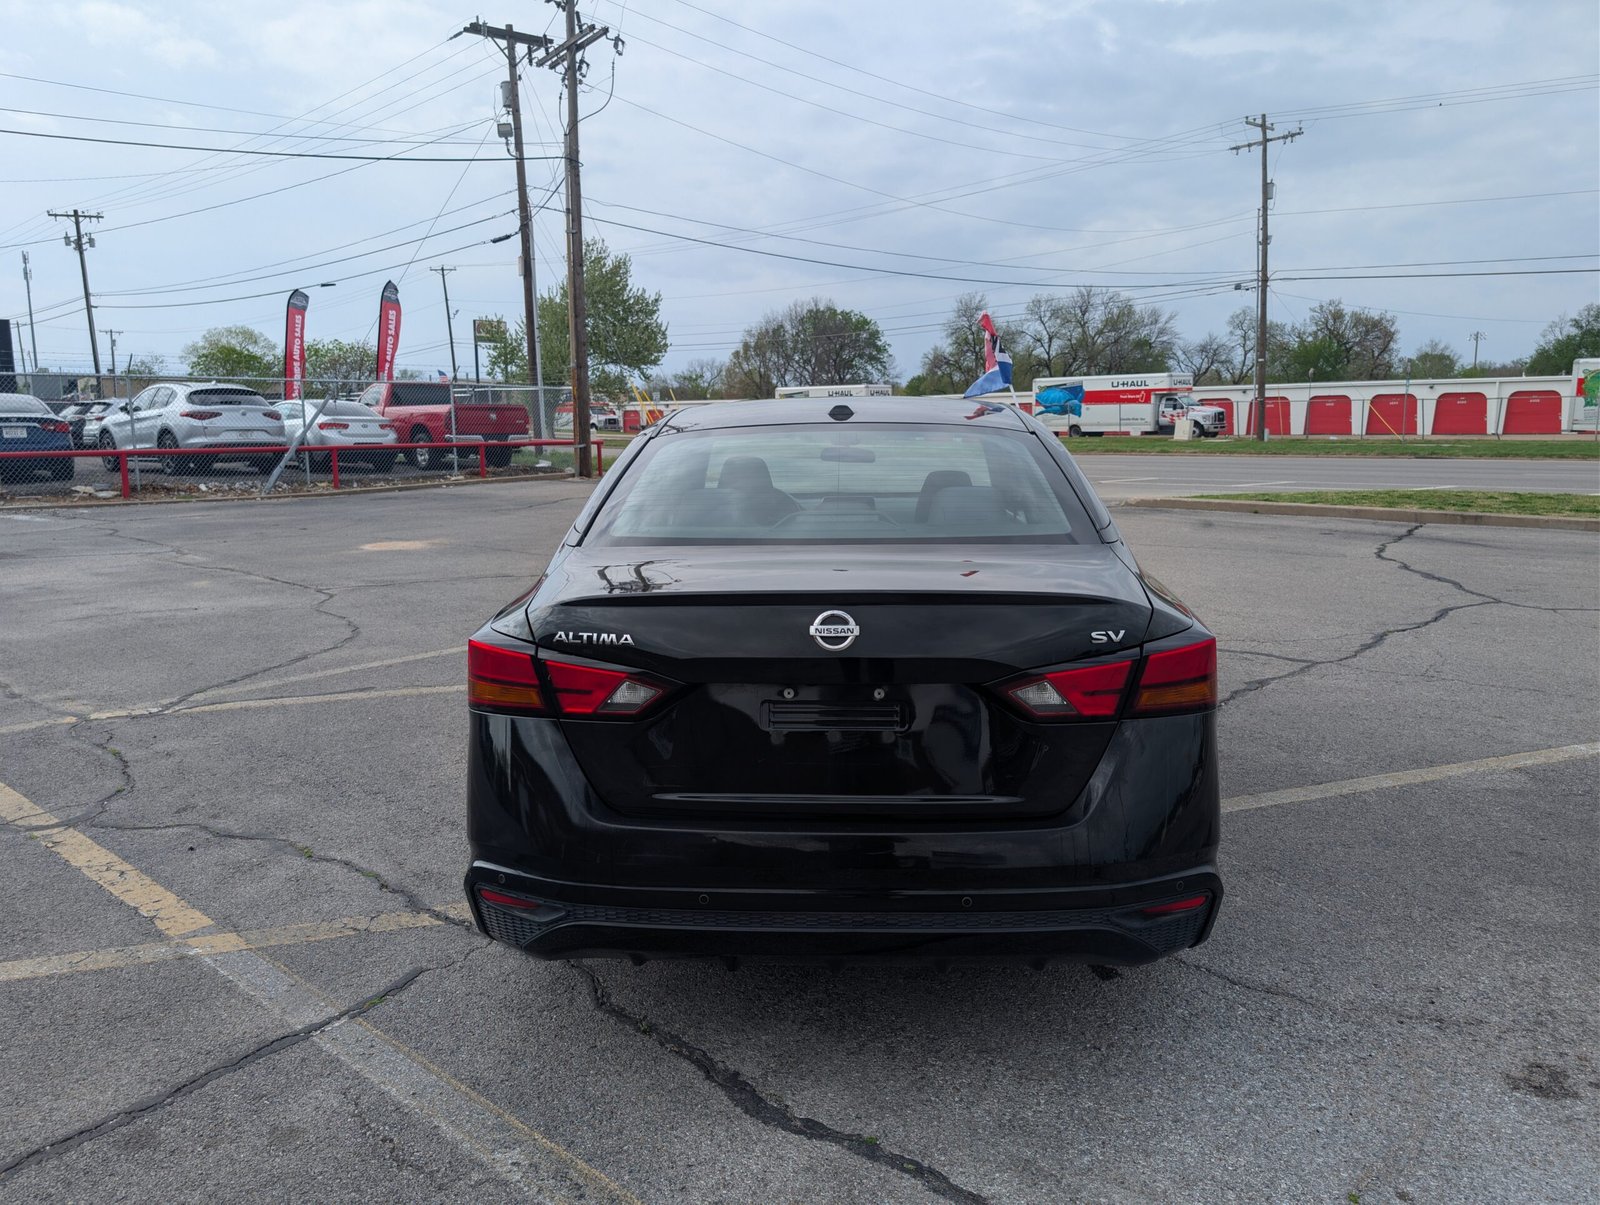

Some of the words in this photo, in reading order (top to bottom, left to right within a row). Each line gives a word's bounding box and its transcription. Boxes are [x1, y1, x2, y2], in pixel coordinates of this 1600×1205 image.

[388, 310, 396, 335] SALES
[293, 339, 301, 360] AUTO
[386, 336, 394, 362] AUTO
[1111, 380, 1149, 388] U-HAUL
[553, 631, 635, 645] ALTIMA
[1091, 630, 1126, 643] SV
